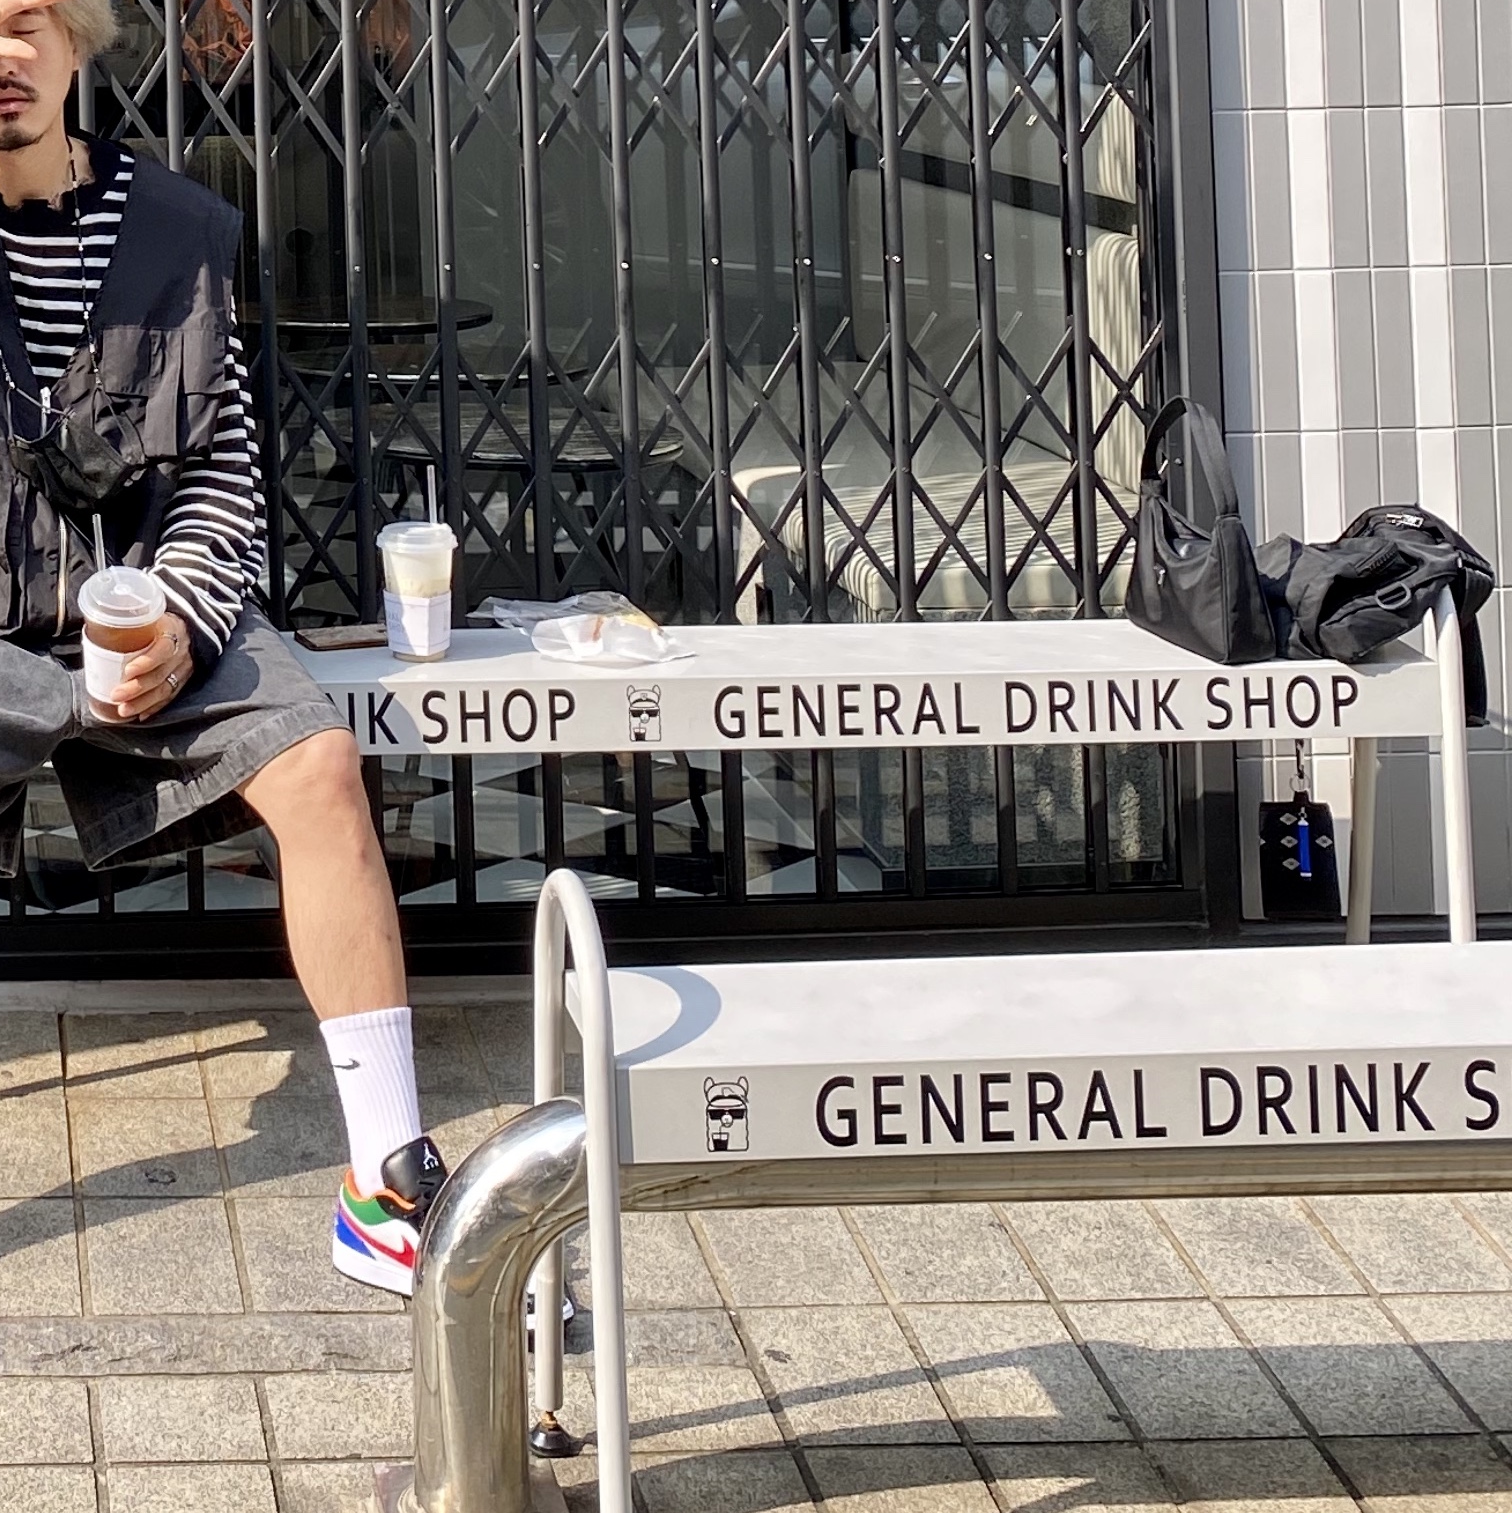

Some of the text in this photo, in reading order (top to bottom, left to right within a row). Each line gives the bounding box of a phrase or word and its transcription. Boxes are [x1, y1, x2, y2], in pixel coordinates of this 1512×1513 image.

[422, 688, 576, 745] SHOP
[714, 674, 1360, 739] GENERAL DRINK SHOP
[816, 1059, 1512, 1148] GENERAL DRINK S
